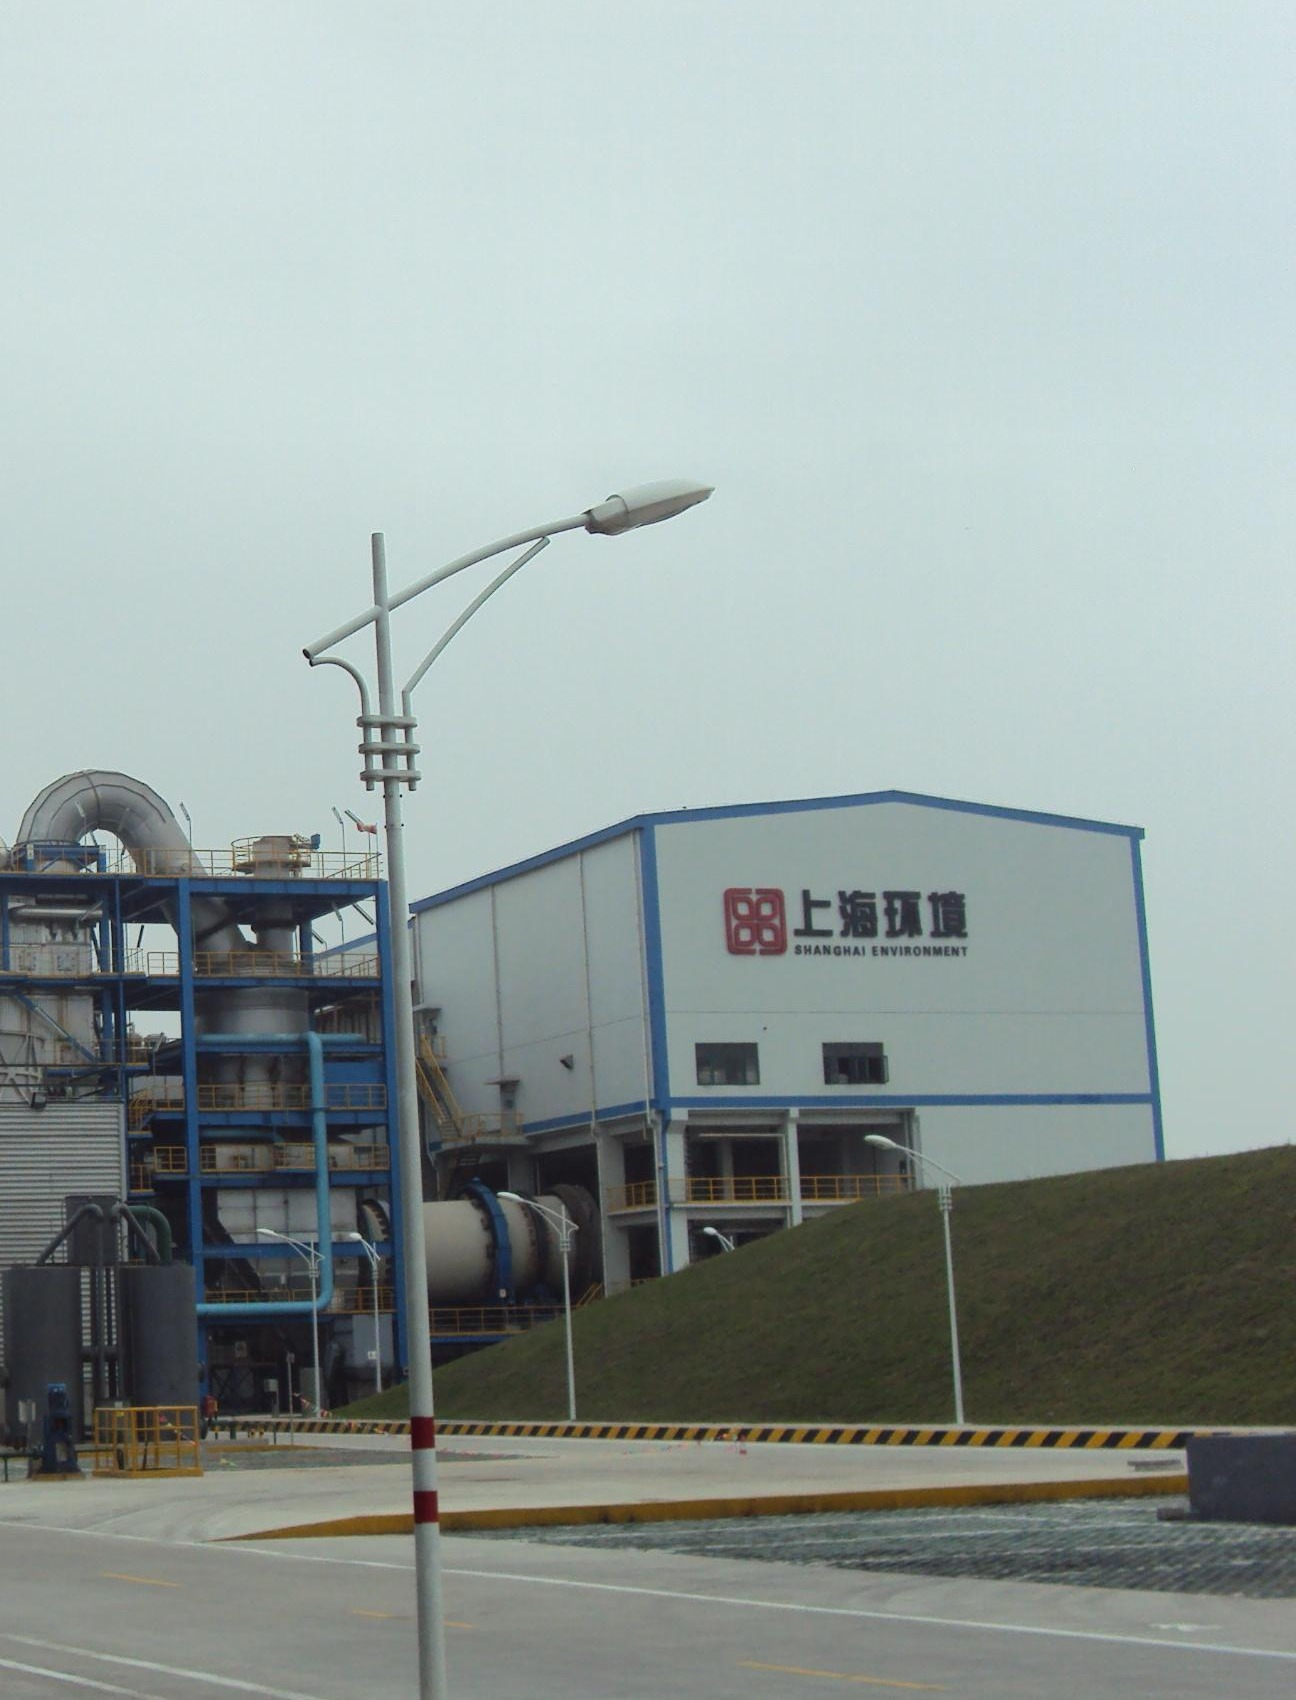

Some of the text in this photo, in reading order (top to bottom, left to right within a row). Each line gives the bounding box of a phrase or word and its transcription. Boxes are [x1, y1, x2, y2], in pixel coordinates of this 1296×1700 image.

[794, 889, 968, 938] 上海环境
[794, 945, 968, 957] SHANGHAI ENVIRONMENT
